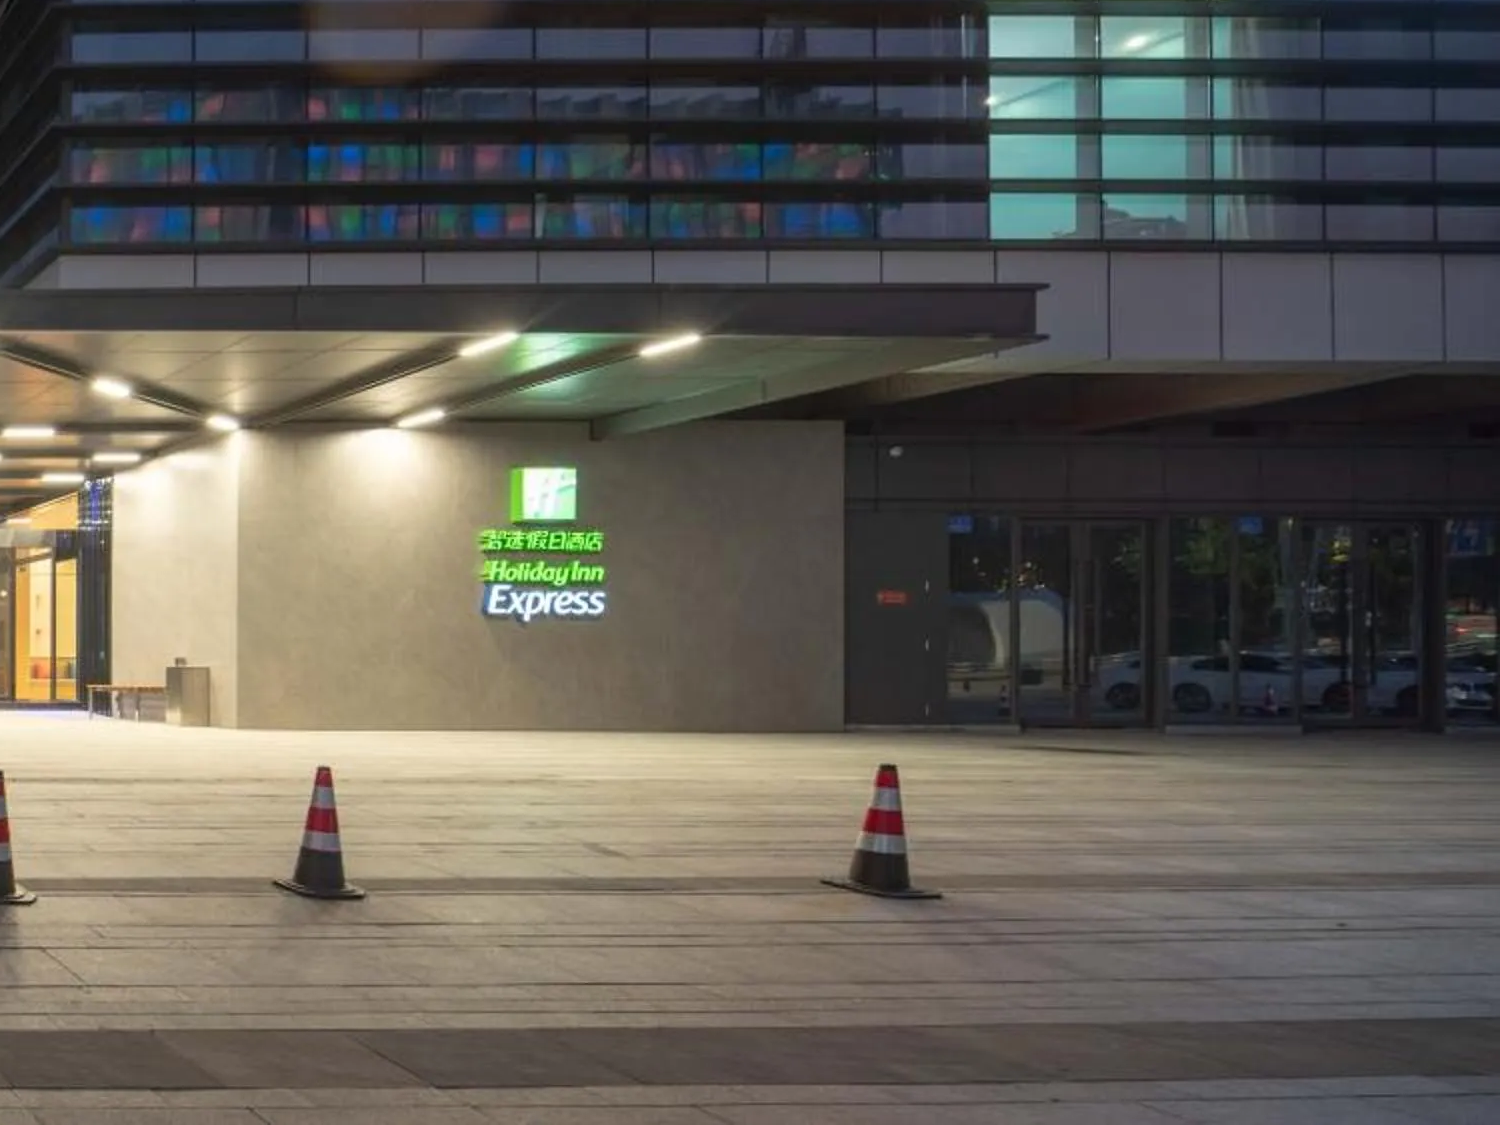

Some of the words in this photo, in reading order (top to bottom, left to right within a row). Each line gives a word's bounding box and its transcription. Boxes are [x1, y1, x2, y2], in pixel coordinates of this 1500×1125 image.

[487, 560, 570, 586] Holiday
[571, 561, 605, 581] Inn
[487, 584, 606, 622] Express
